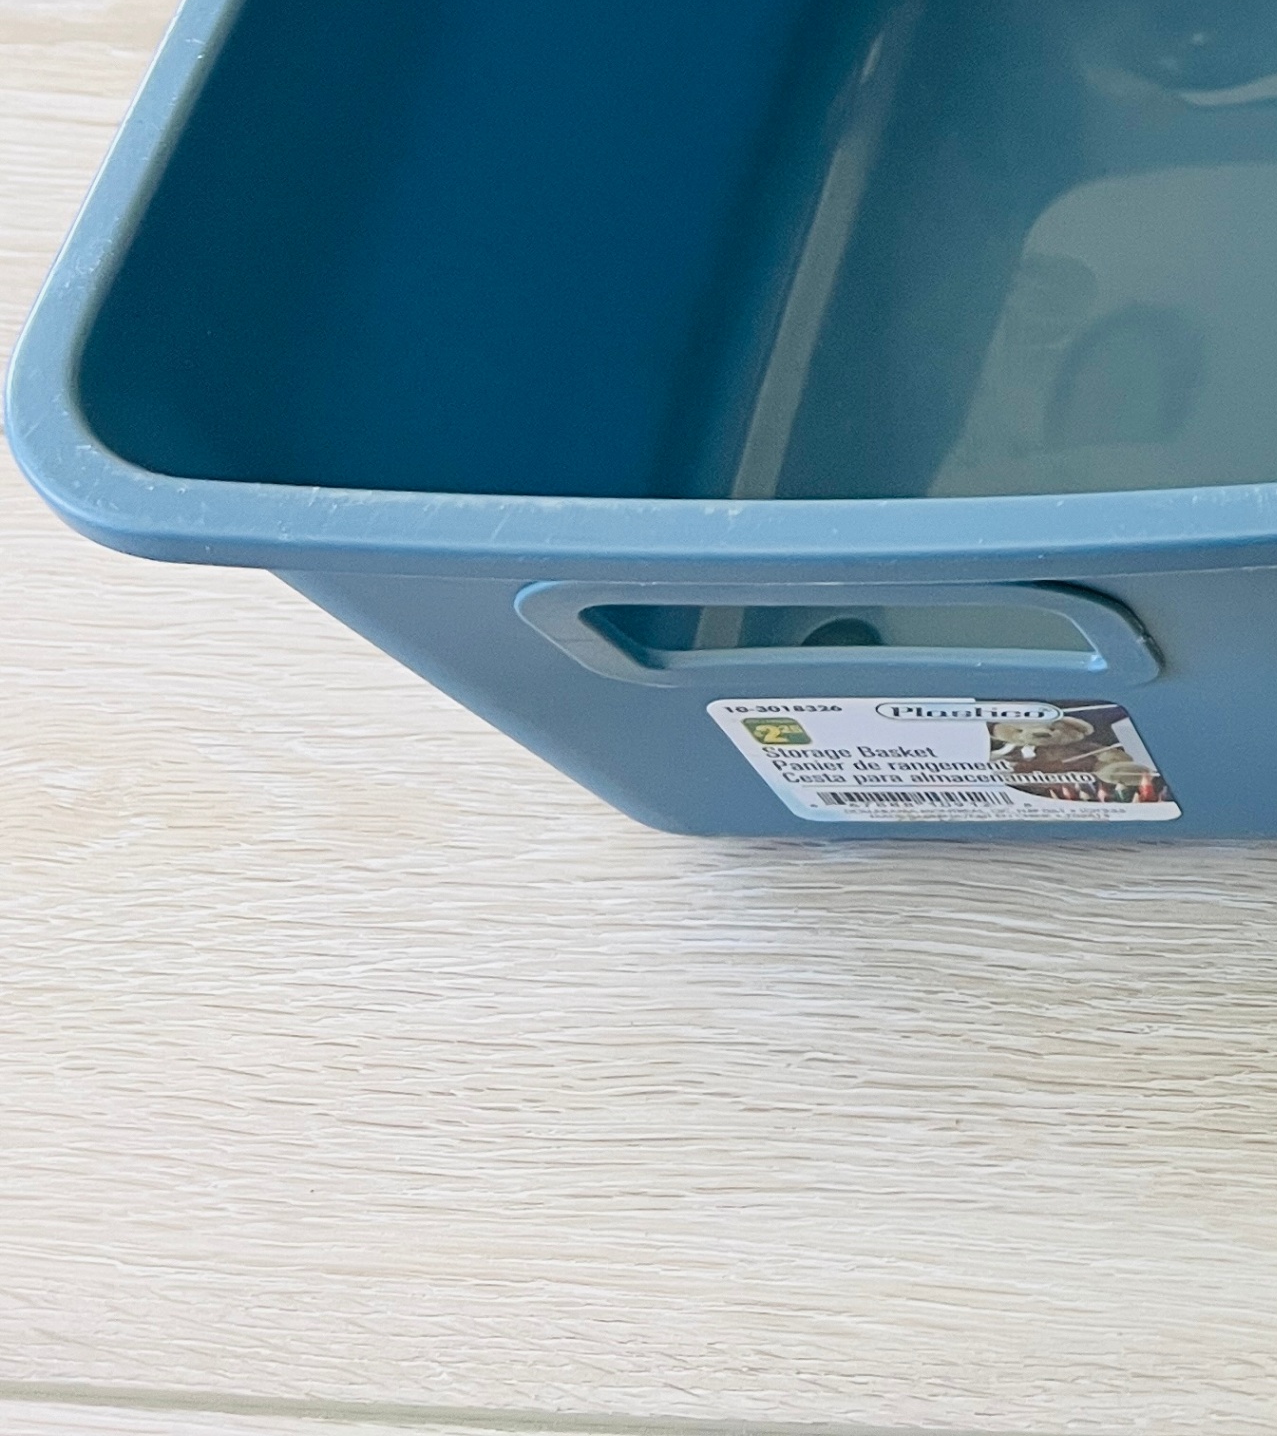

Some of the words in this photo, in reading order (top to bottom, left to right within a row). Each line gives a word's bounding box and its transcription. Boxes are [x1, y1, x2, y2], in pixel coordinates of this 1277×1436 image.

[762, 746, 852, 760] Storage
[856, 746, 938, 759] Basket
[772, 760, 846, 772] Panier
[855, 760, 882, 771] de
[888, 761, 1009, 773] rangement
[782, 772, 847, 783] Cesta
[853, 773, 904, 785] para
[910, 771, 1096, 784] almacenamiento
